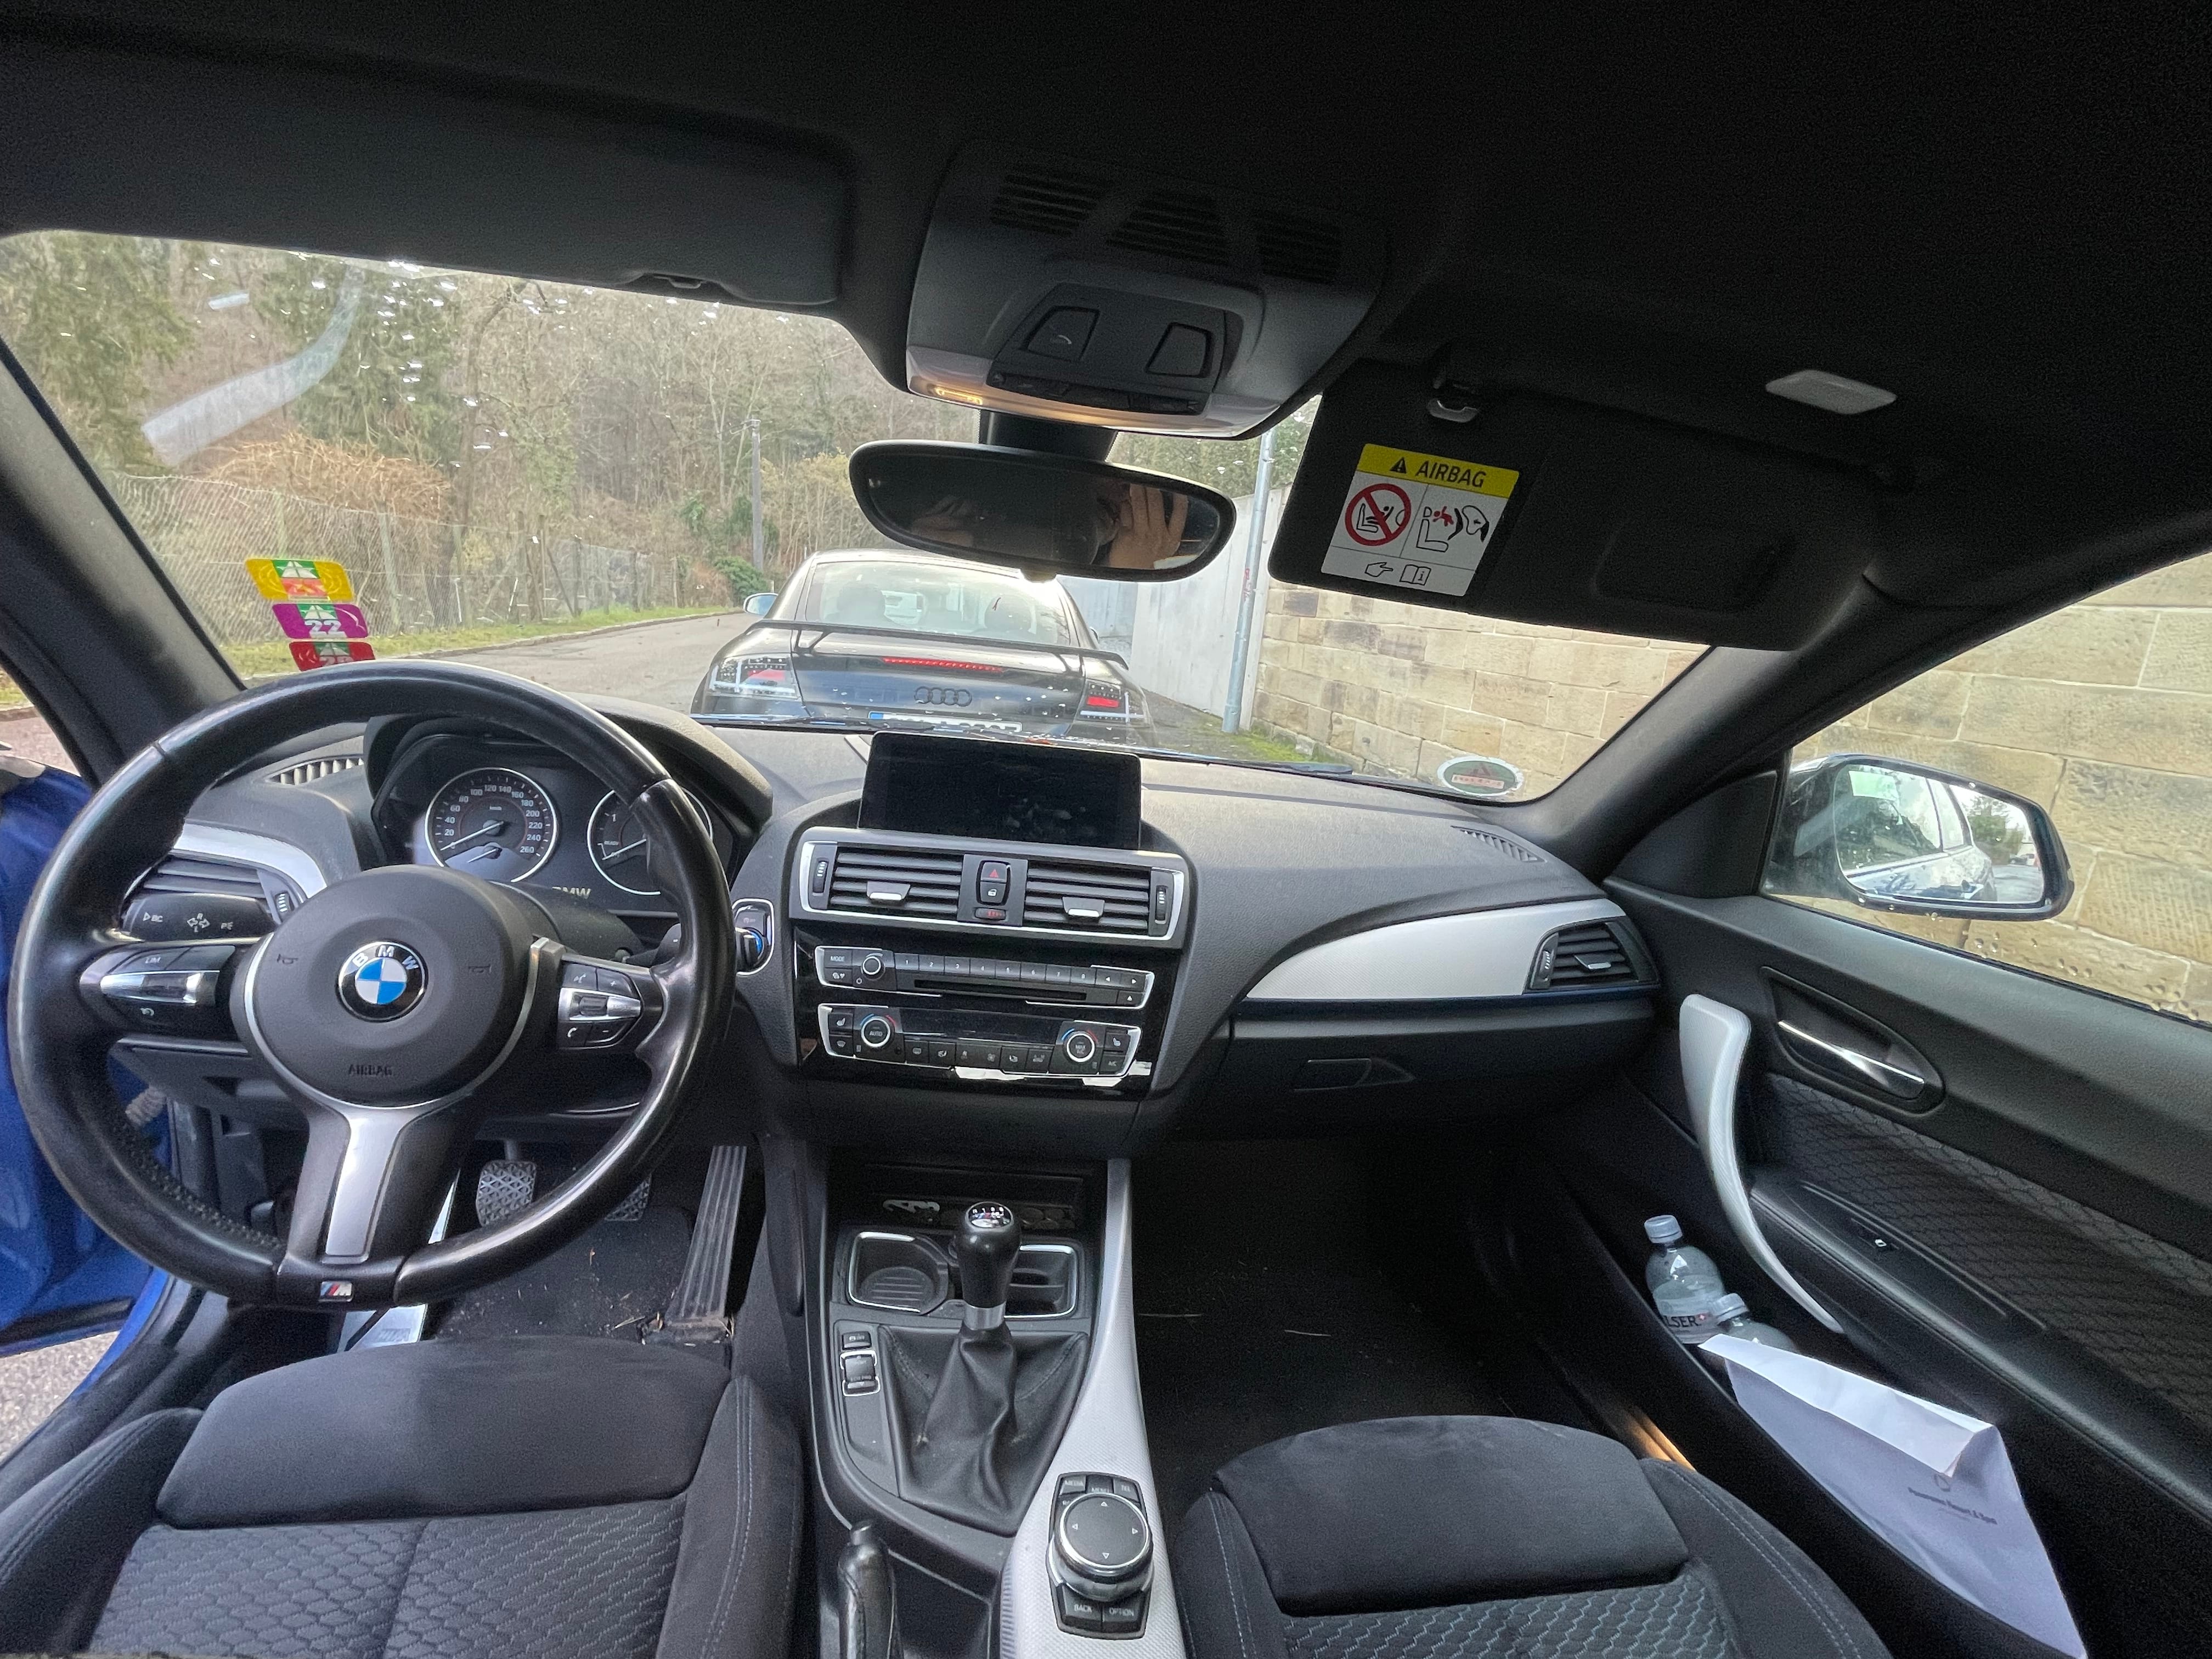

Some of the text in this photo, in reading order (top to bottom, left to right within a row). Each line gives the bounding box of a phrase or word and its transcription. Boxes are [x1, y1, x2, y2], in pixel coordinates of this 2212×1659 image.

[1415, 461, 1486, 488] AIRBAG
[612, 814, 617, 822] 1
[552, 886, 591, 899] MW
[352, 945, 419, 969] BMW
[1074, 1604, 1092, 1613] BACK
[1109, 1607, 1134, 1616] OPTION
